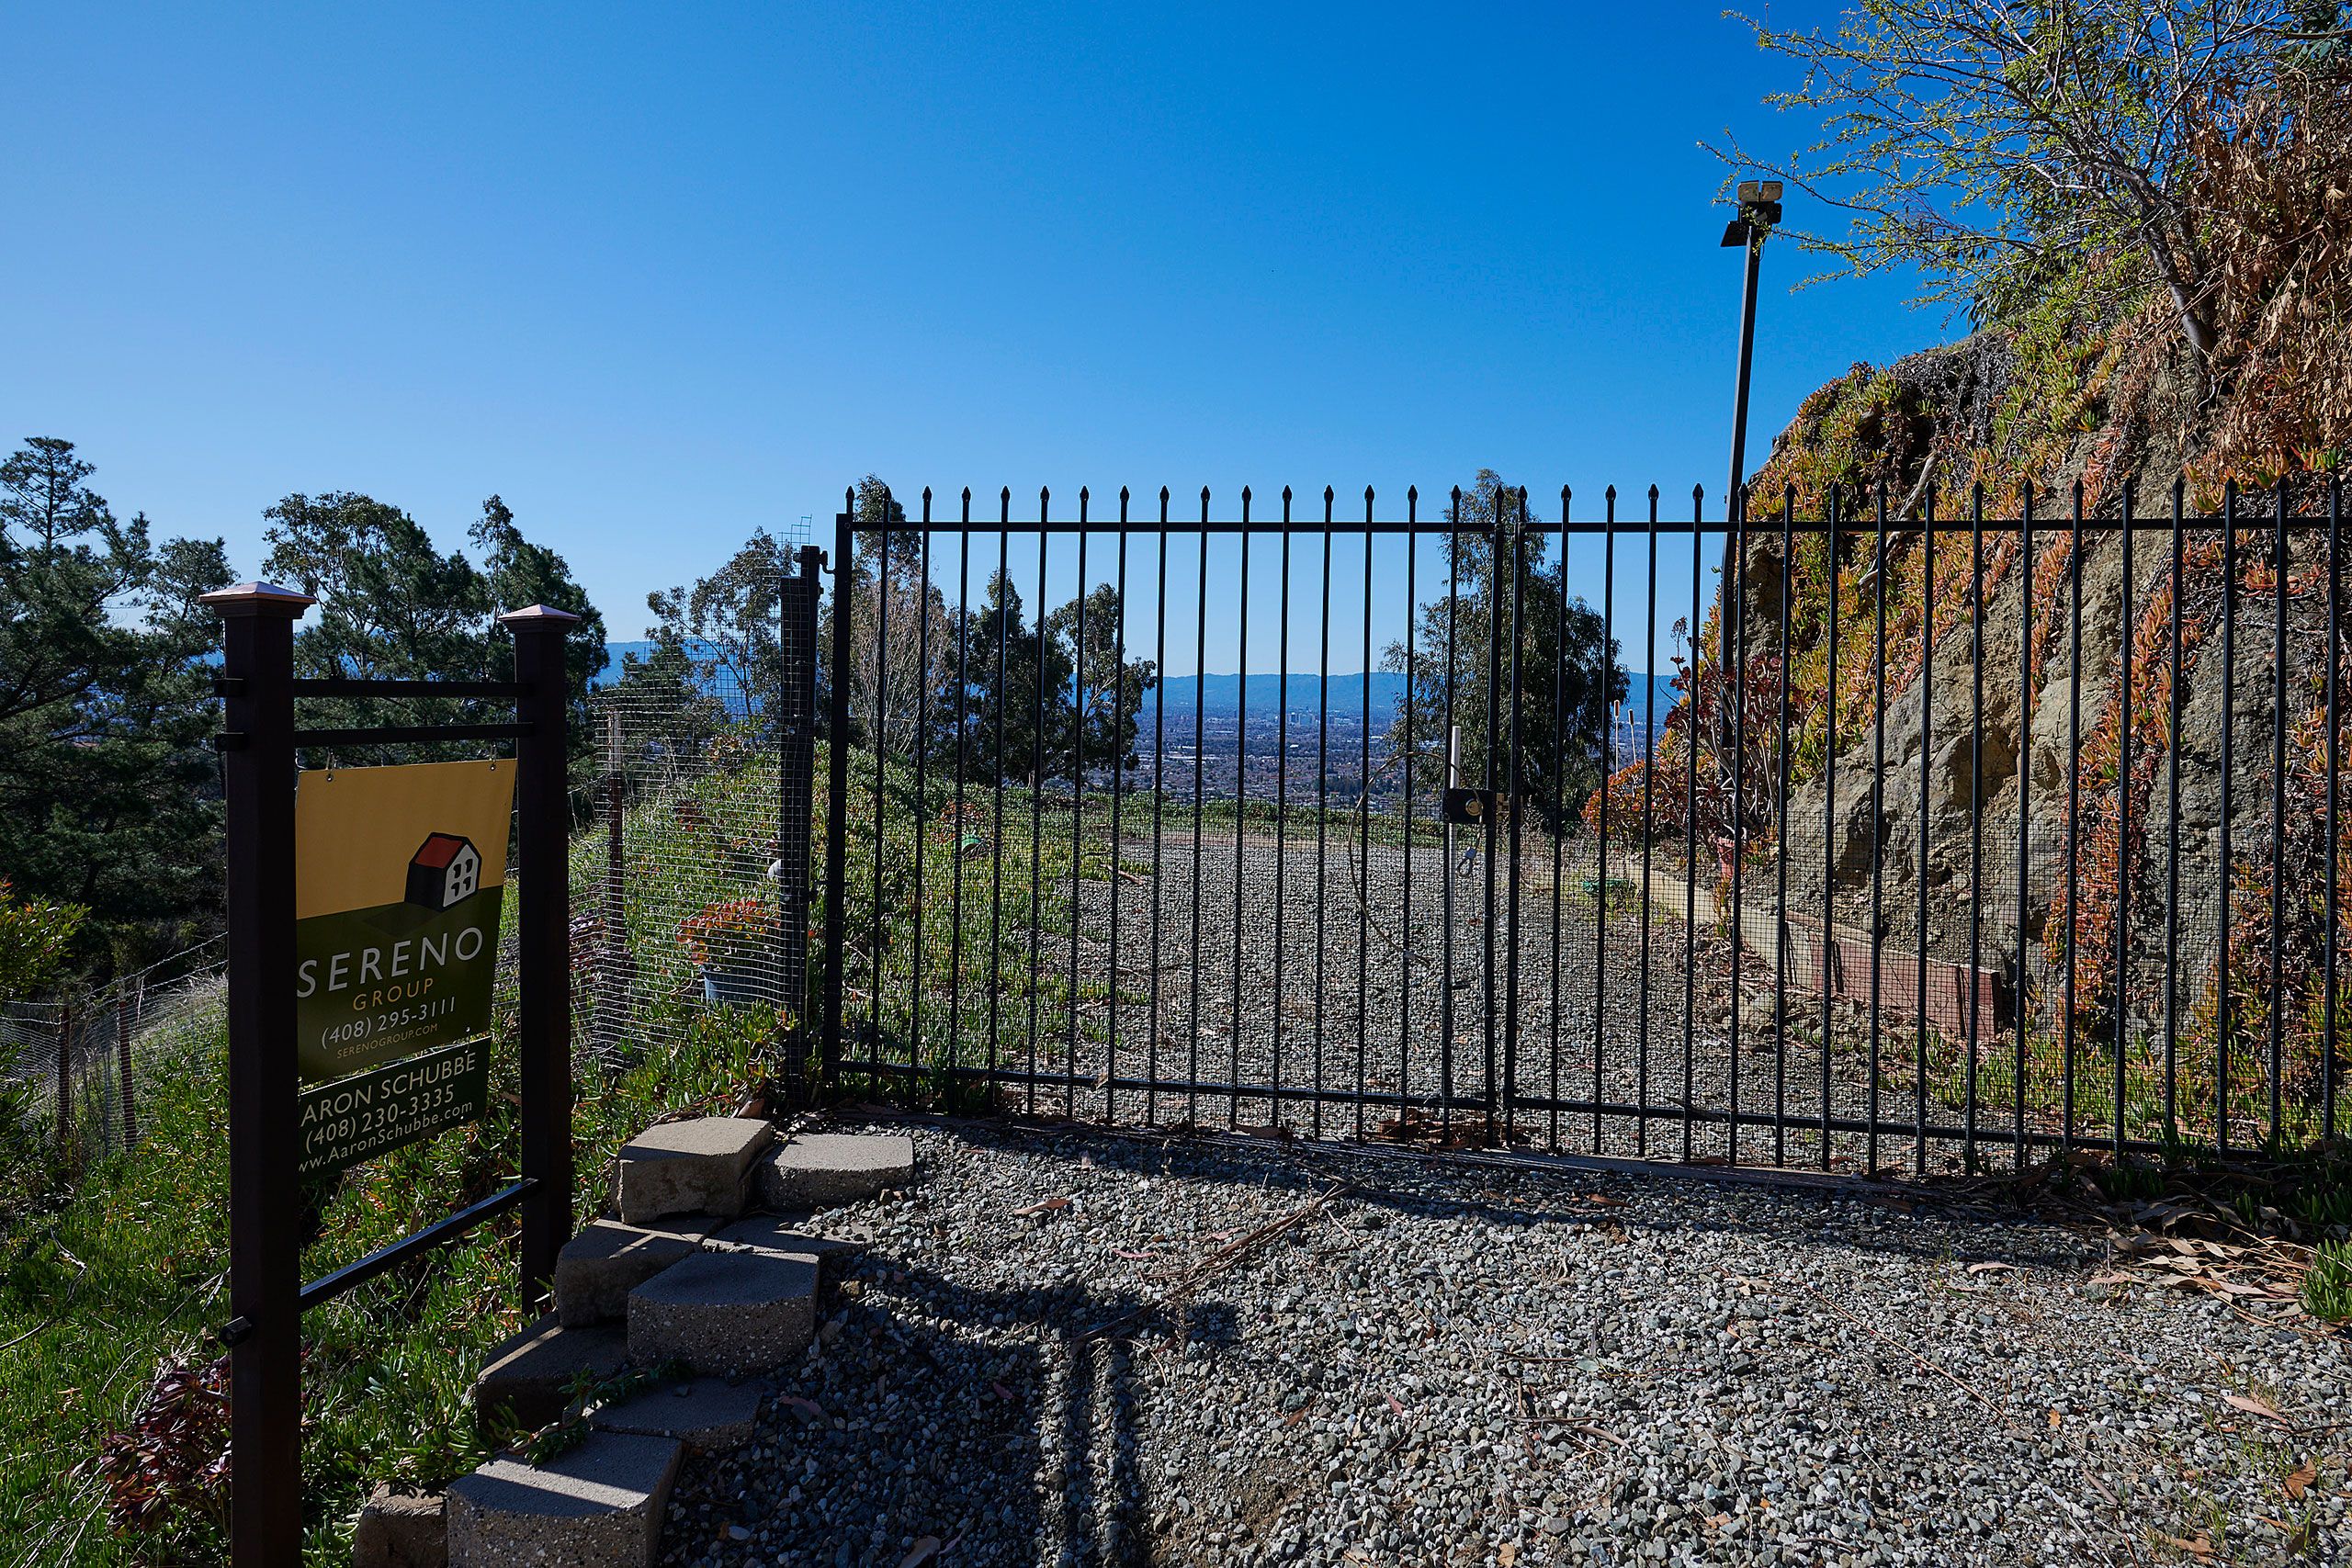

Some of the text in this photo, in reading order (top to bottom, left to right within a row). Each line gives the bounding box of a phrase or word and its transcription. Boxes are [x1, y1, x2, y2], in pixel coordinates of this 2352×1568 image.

[297, 927, 483, 998] SERENO
[353, 978, 434, 1011] GROUP
[322, 997, 456, 1049] (408) 295-3111
[336, 1023, 438, 1059] SERENOGROUP.COM
[380, 1053, 476, 1099] SCHUBBE
[305, 1084, 455, 1154] (408) 230-3335
